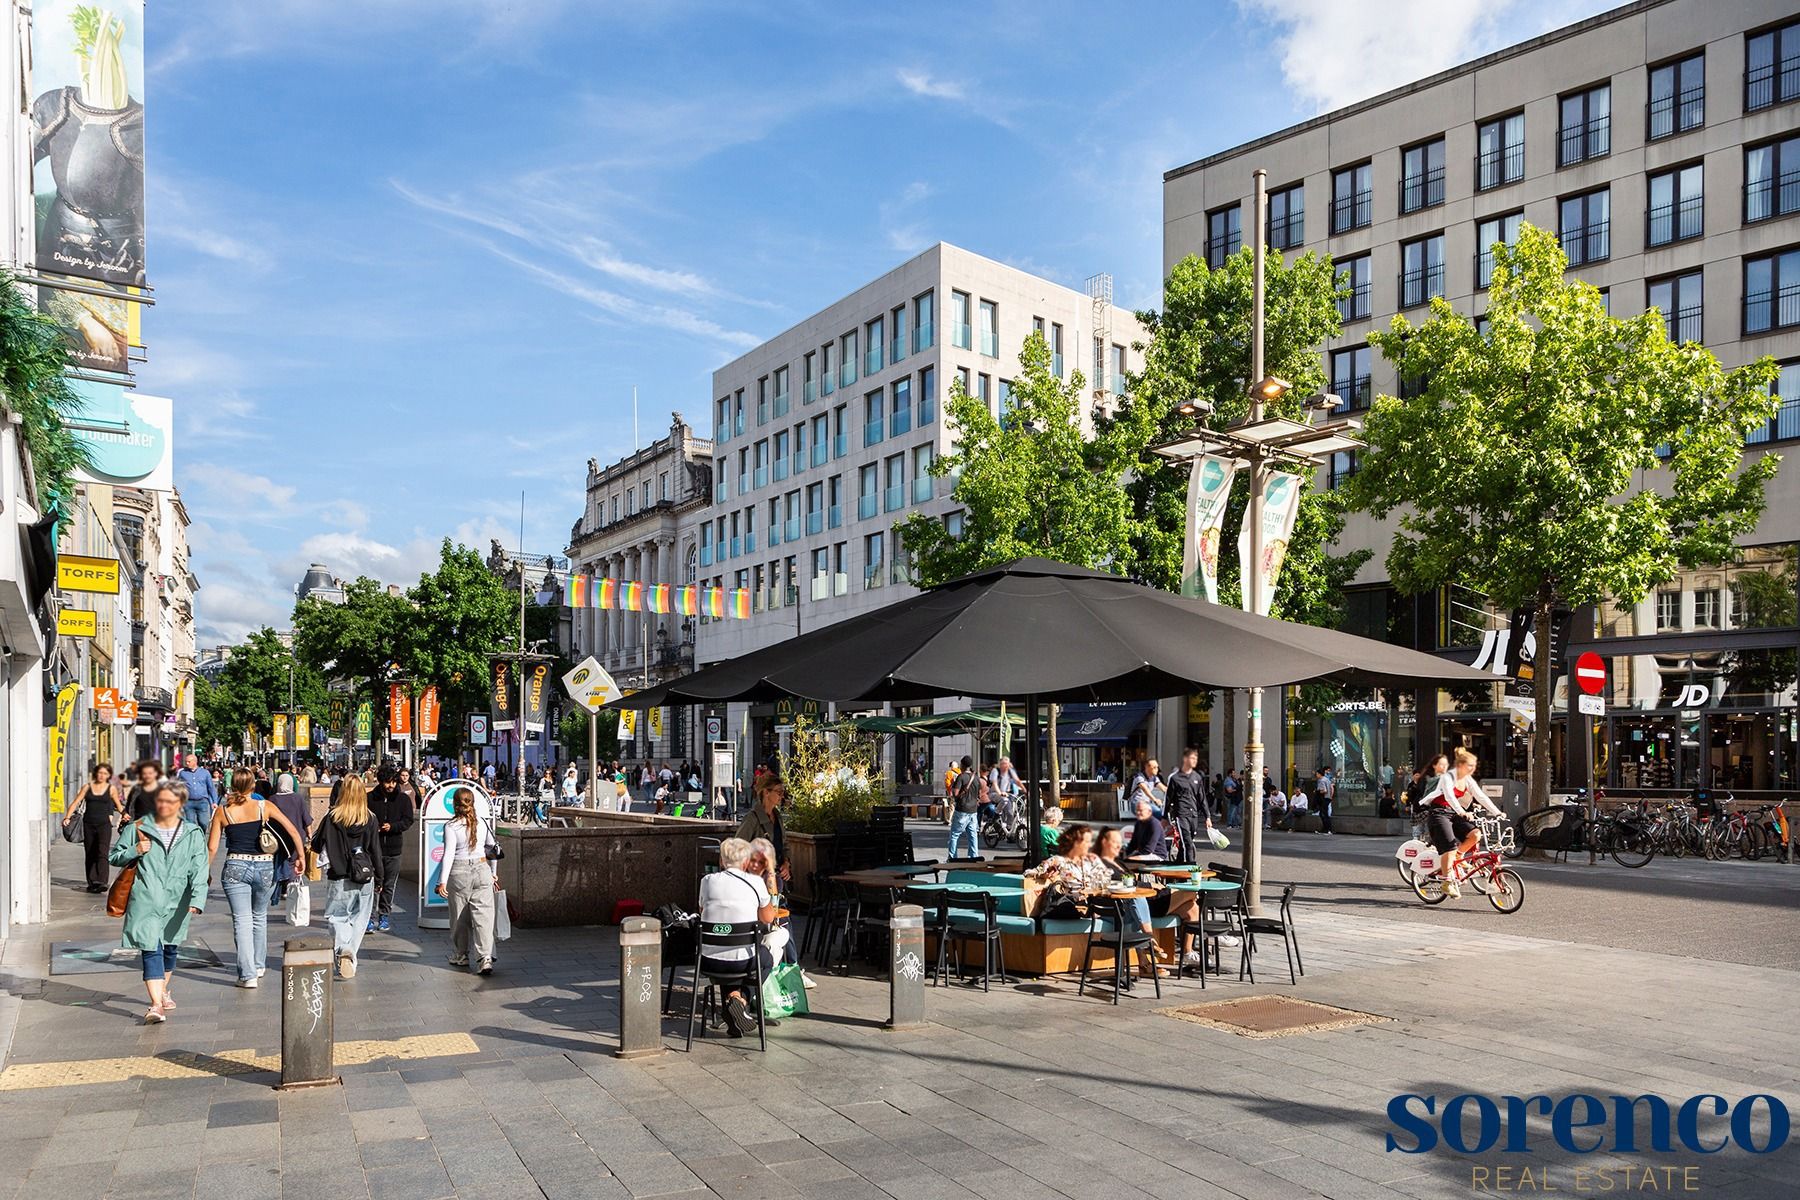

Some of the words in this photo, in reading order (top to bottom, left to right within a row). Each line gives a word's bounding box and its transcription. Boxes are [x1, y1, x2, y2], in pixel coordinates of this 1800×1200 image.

[53, 252, 83, 266] Design
[84, 258, 95, 270] by
[62, 568, 115, 580] TORFS
[60, 619, 93, 627] ORFS
[495, 663, 508, 711] Orange
[529, 665, 547, 712] Orange
[1672, 685, 1709, 707] JD
[623, 710, 632, 730] Pan
